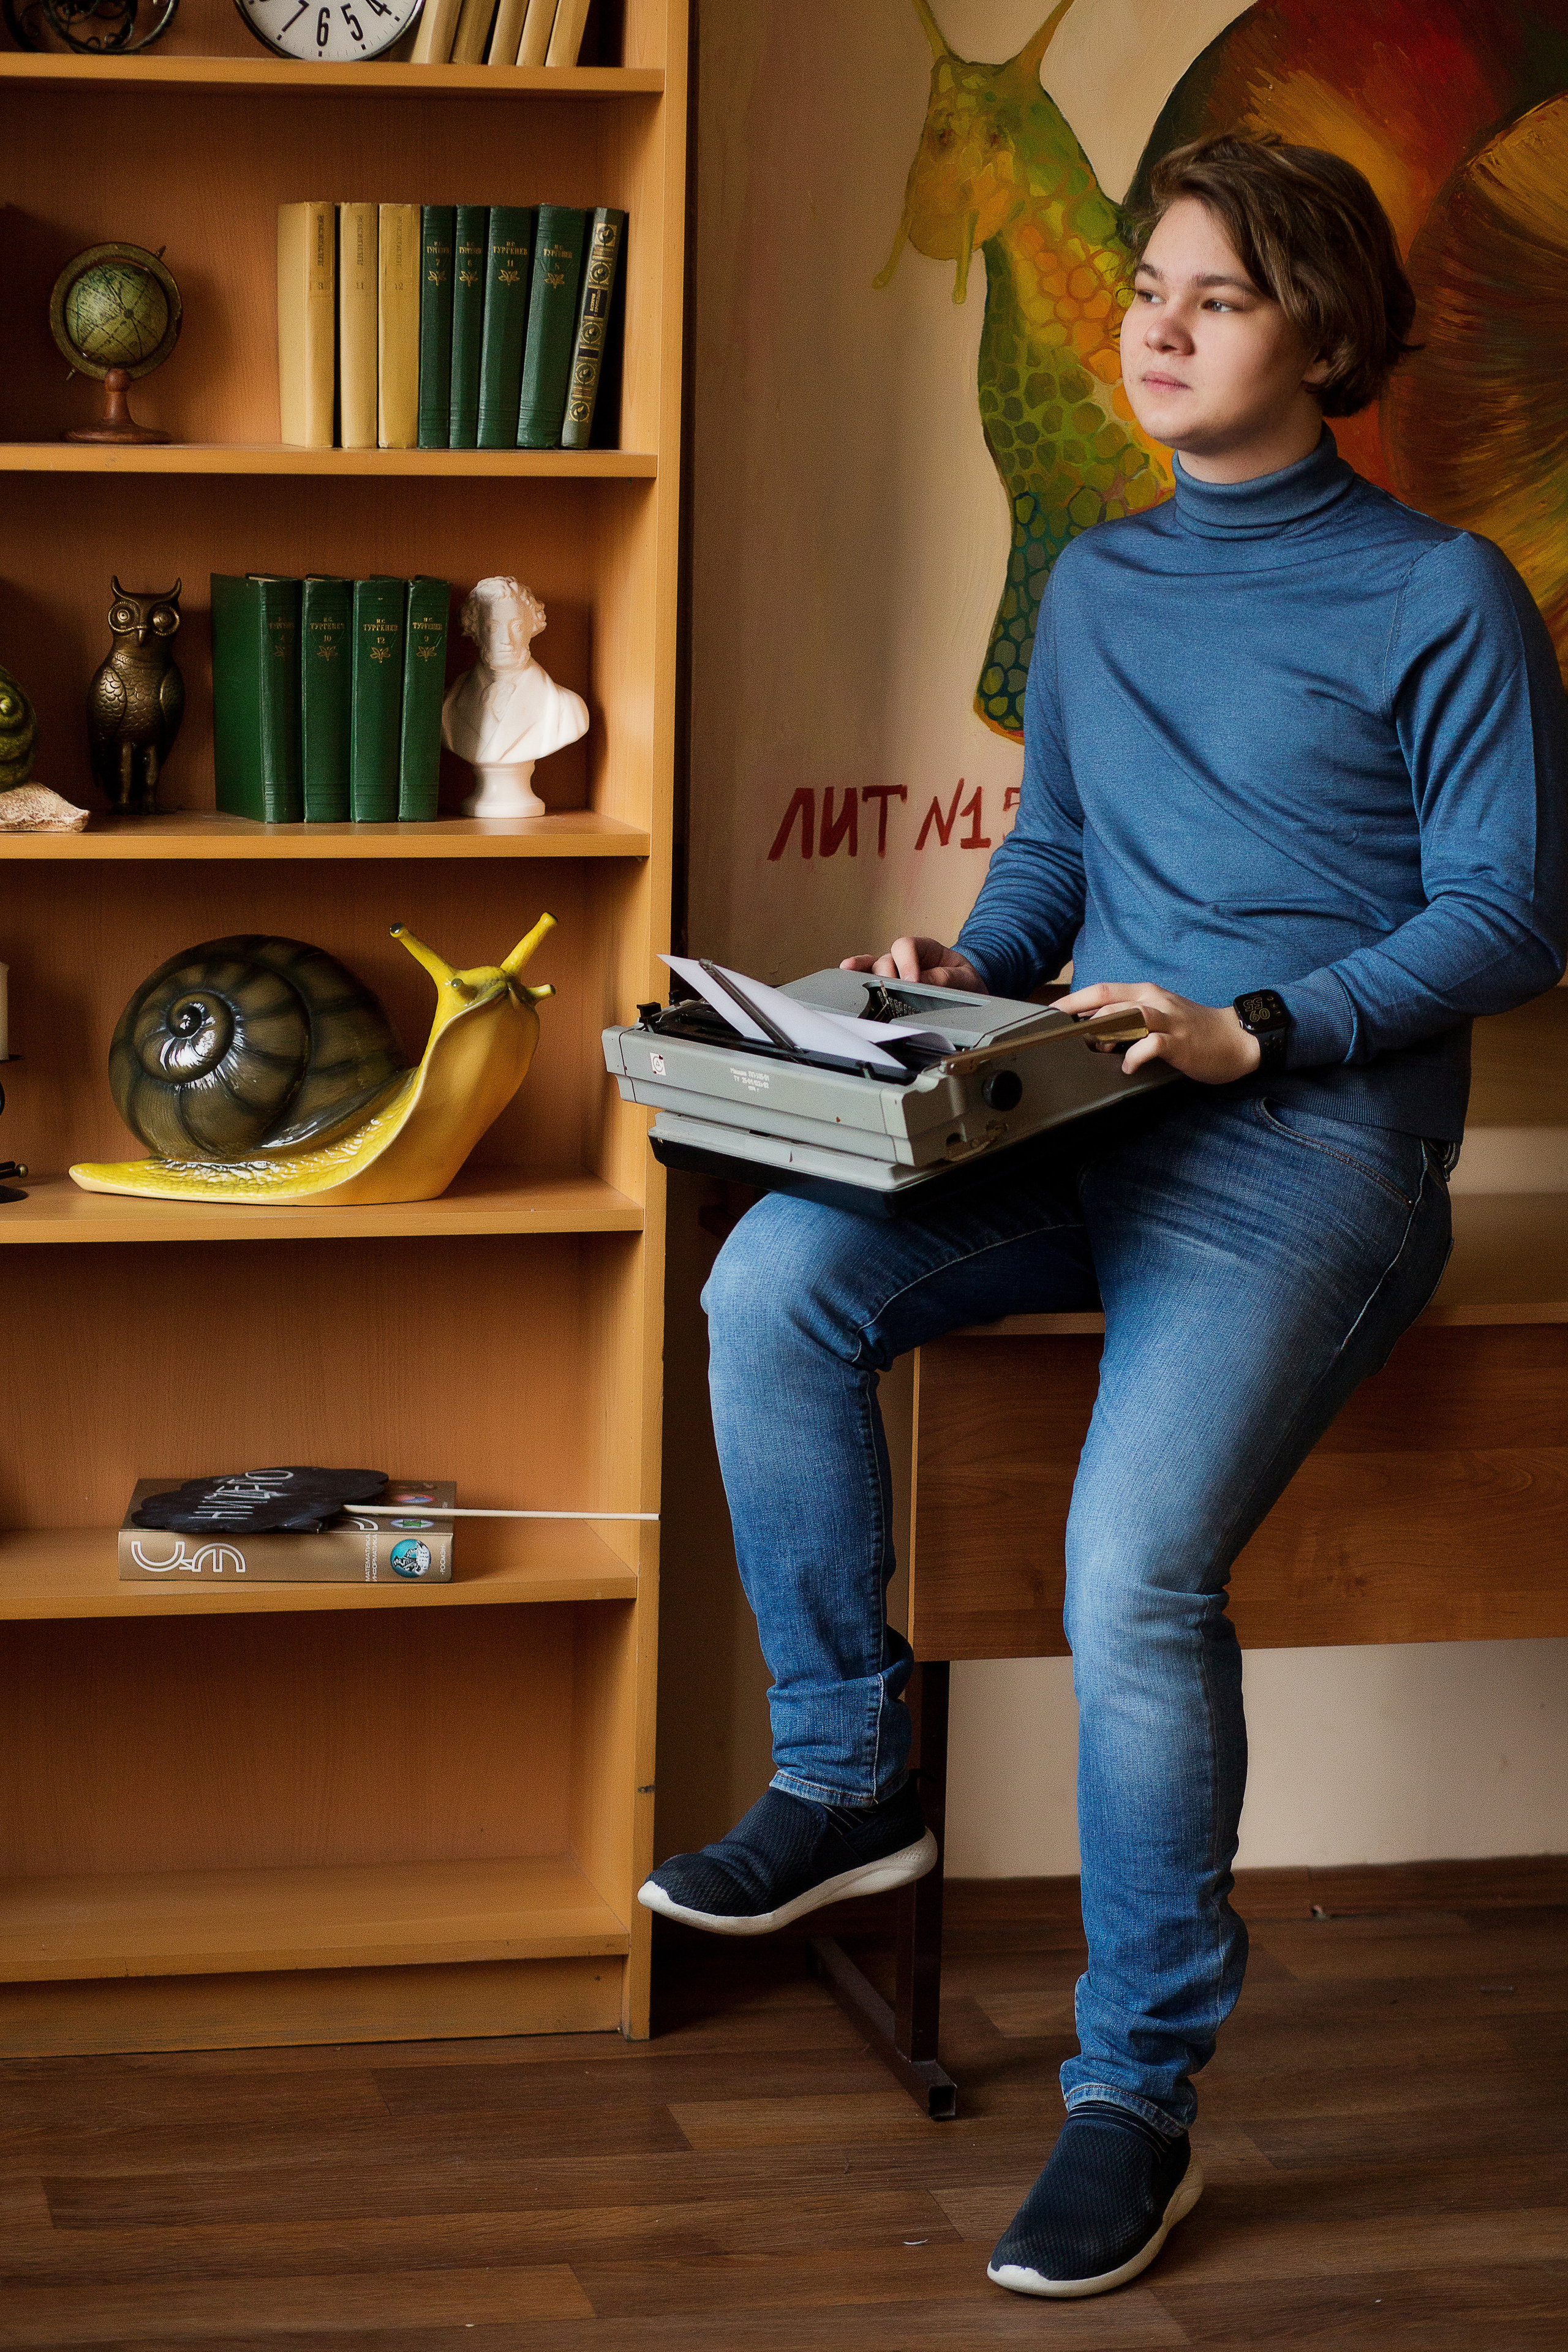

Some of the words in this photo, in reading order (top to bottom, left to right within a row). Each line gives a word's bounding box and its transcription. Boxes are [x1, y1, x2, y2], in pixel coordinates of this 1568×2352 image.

[279, 0, 310, 32] 7
[316, 7, 330, 47] 6
[340, 2, 364, 41] 5
[493, 246, 527, 255] ТУРГЕНЕВ
[412, 622, 442, 630] ТУРГЕНЕВ
[767, 785, 908, 861] ЛИТ
